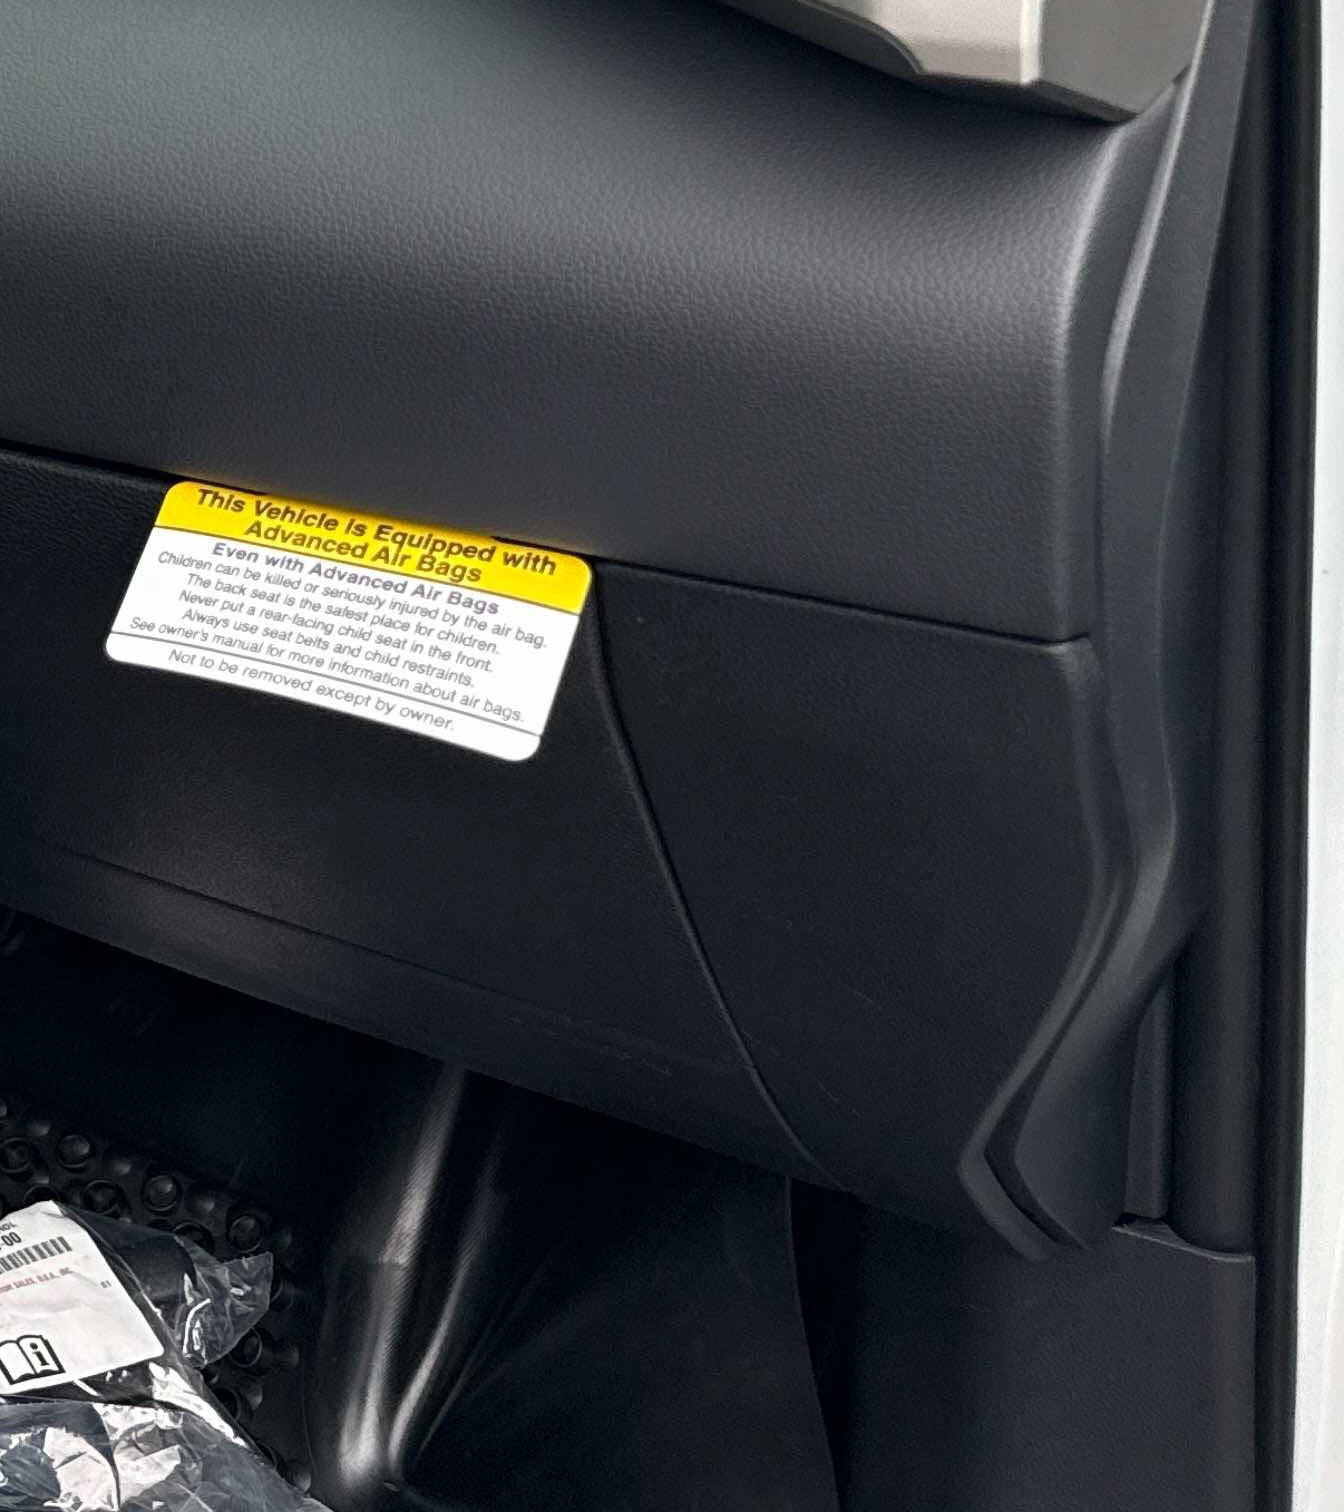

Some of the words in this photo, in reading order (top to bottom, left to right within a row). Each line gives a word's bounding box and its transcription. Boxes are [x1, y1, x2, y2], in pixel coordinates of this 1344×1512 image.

[197, 487, 246, 513] This
[254, 498, 344, 531] Vehicle
[343, 517, 368, 537] is
[372, 523, 498, 563] Equipped
[502, 550, 557, 576] with
[242, 519, 369, 559] Advanced
[369, 545, 412, 567] Air
[415, 553, 482, 584] Bags
[157, 549, 213, 571] Children
[213, 562, 241, 577] can
[242, 566, 262, 582] be
[263, 571, 302, 590] killed
[302, 581, 320, 594] or
[320, 585, 387, 610] seriously
[387, 597, 440, 620] injured
[440, 608, 461, 627] by
[462, 614, 488, 632] the
[490, 622, 512, 638] air
[513, 625, 547, 650] bag.
[186, 571, 212, 589] The
[213, 577, 248, 596] back
[248, 587, 282, 603] seat
[282, 593, 296, 607] is
[298, 596, 322, 612] the
[323, 604, 369, 622] safest
[368, 613, 411, 632] place
[413, 620, 436, 637] for
[435, 628, 500, 655] children.
[210, 541, 259, 563] Even
[264, 554, 305, 574] with
[306, 561, 409, 594] Advanced
[409, 582, 443, 601] Air
[445, 589, 499, 615] Bags
[128, 615, 156, 632] See
[157, 623, 209, 642] owner's
[210, 633, 264, 654] manual
[264, 642, 286, 658] for
[286, 650, 325, 668] more
[327, 656, 410, 690] information
[411, 681, 457, 703] about
[458, 693, 481, 709] air
[481, 696, 524, 722] bags.
[177, 588, 220, 607] Never
[218, 599, 245, 613] put
[245, 605, 256, 616] a
[257, 607, 335, 636] rear-facing
[336, 624, 373, 642] child
[373, 633, 408, 650] seat
[408, 639, 424, 655] in
[426, 643, 452, 662] the
[454, 649, 493, 673] front.
[180, 607, 230, 629] Always
[231, 620, 259, 635] use
[260, 626, 294, 643] seat
[294, 631, 331, 651] belts
[331, 642, 363, 658] and
[363, 648, 401, 667] child
[400, 658, 475, 688] restraints.
[167, 647, 197, 665] Not
[198, 654, 215, 669] to
[216, 657, 239, 674] be
[240, 665, 314, 692] removed
[314, 683, 372, 707] except
[373, 695, 396, 716] by
[398, 706, 454, 730] owner.
